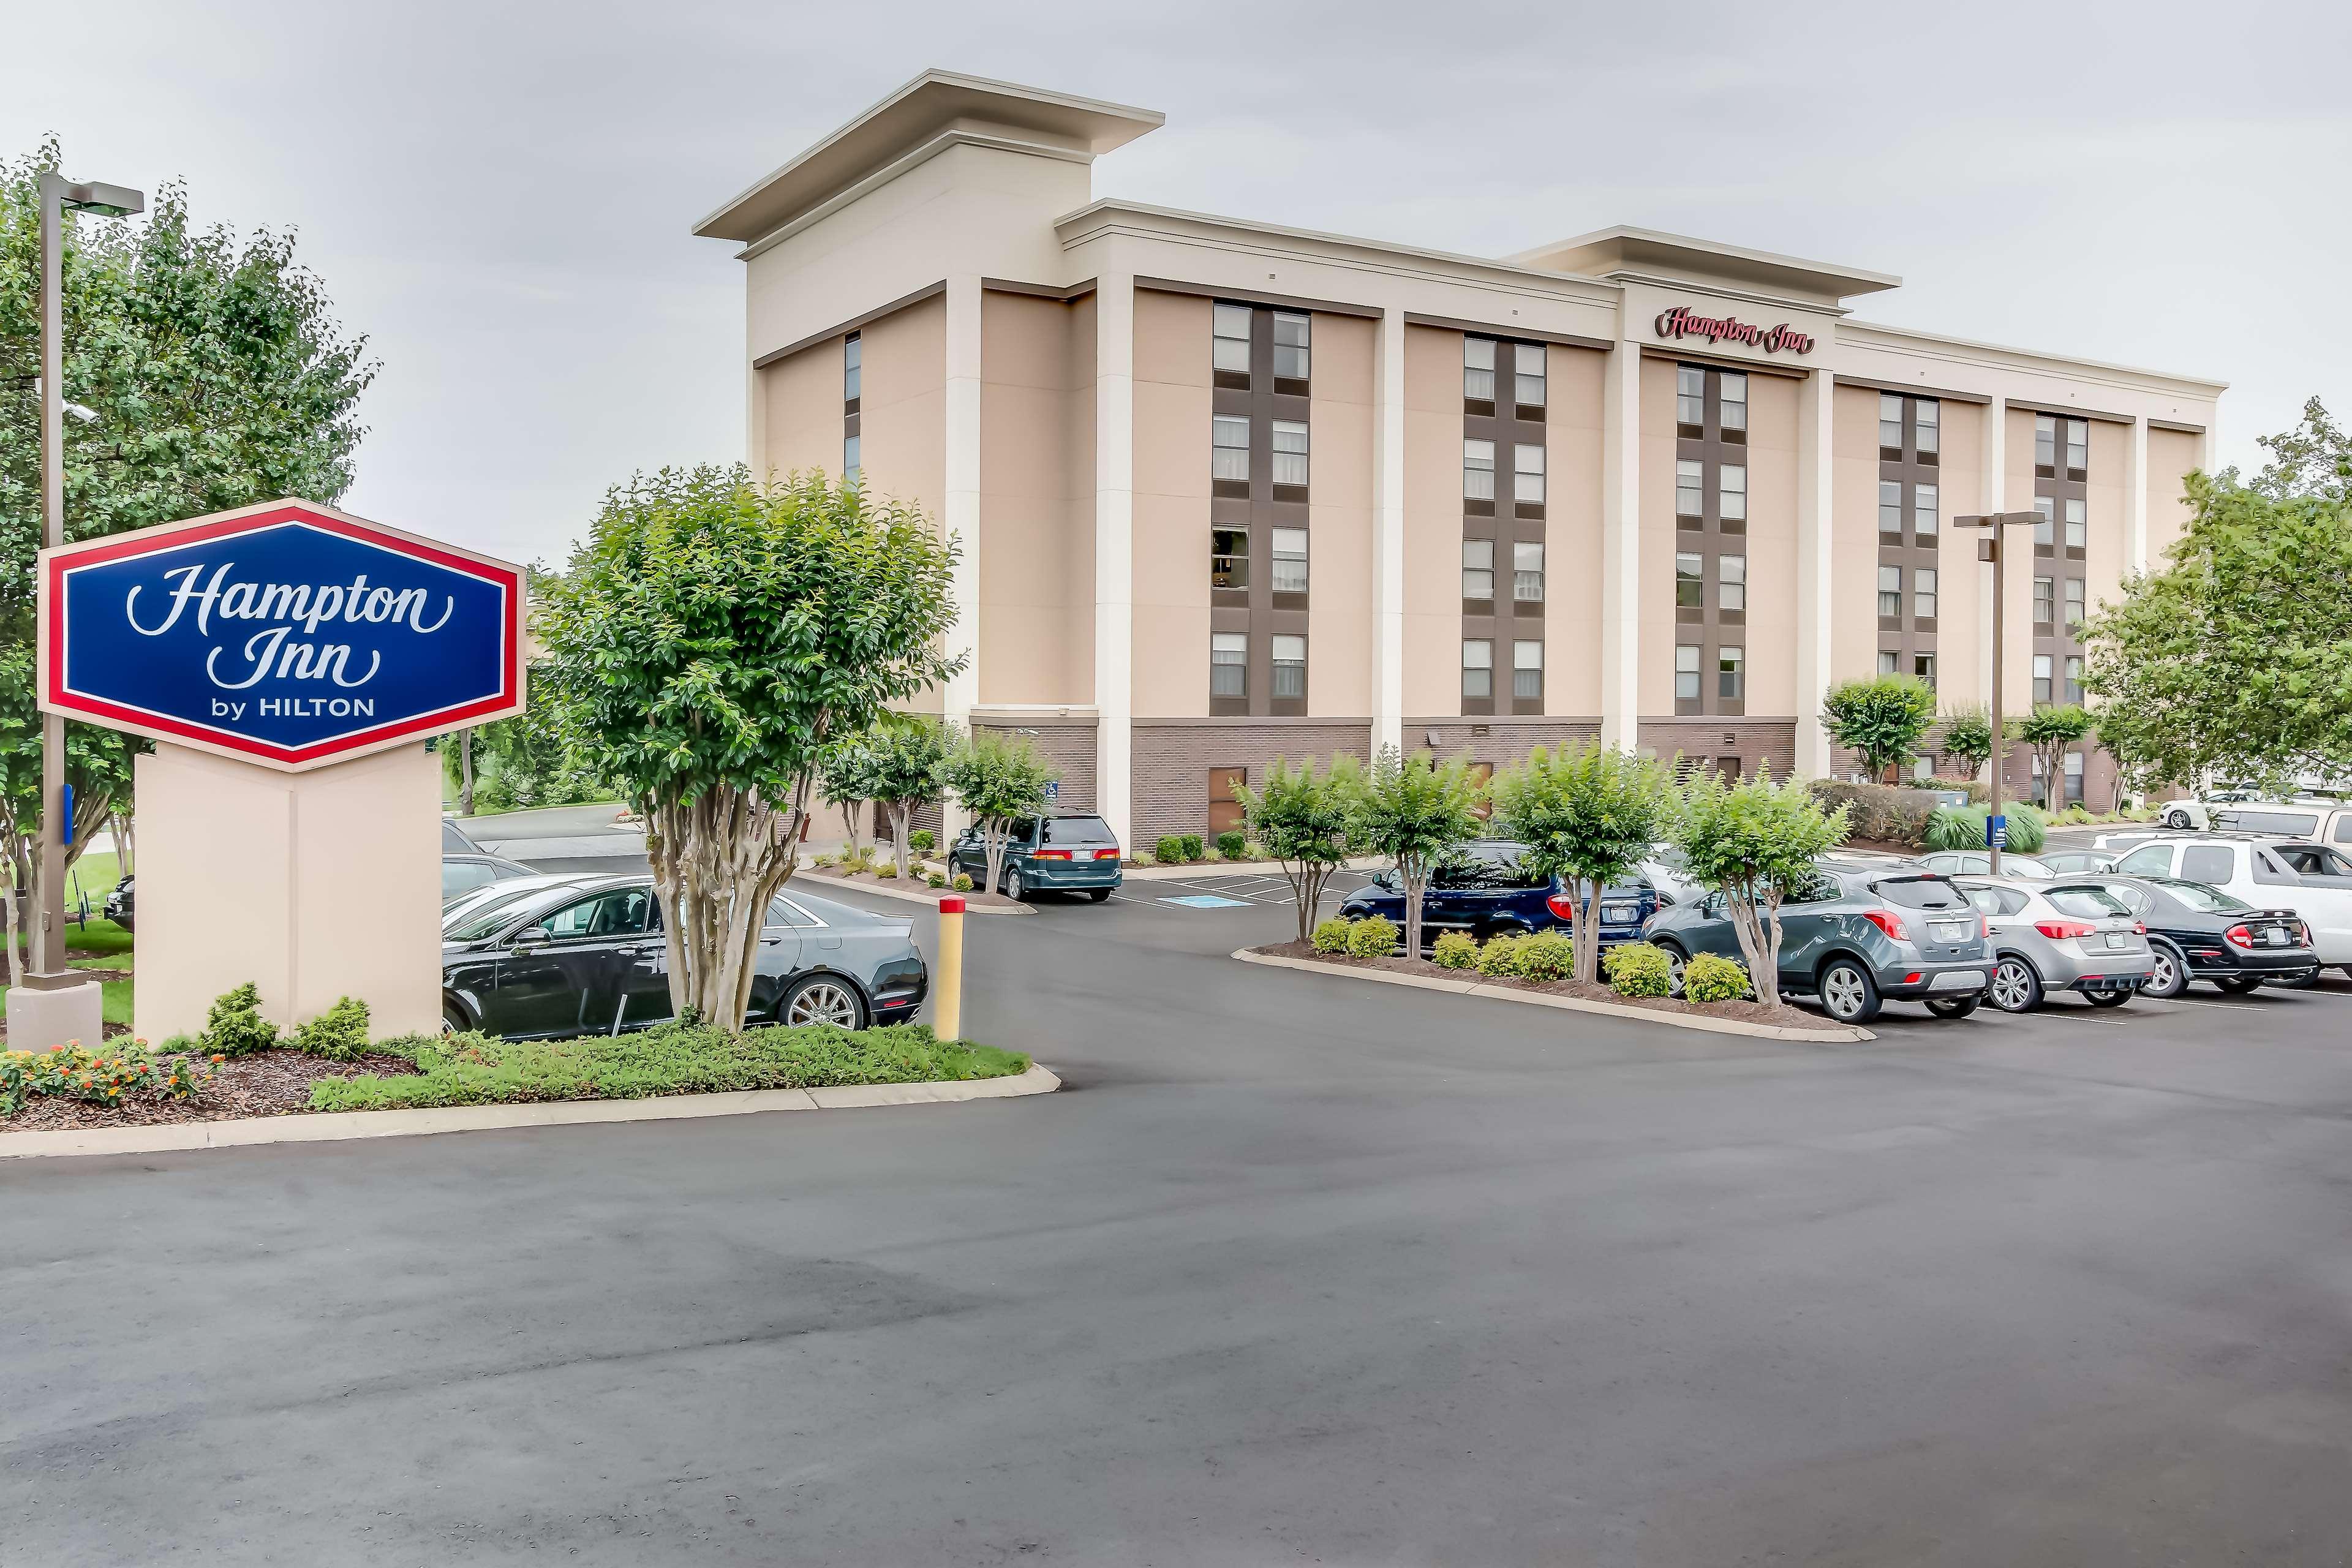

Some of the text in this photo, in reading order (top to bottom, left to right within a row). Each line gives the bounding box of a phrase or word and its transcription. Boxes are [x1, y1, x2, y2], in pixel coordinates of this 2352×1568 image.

[1655, 306, 1814, 355] Hampton Inn
[127, 562, 453, 636] Hampton
[207, 627, 380, 689] Inn
[213, 698, 373, 720] by HILTON
